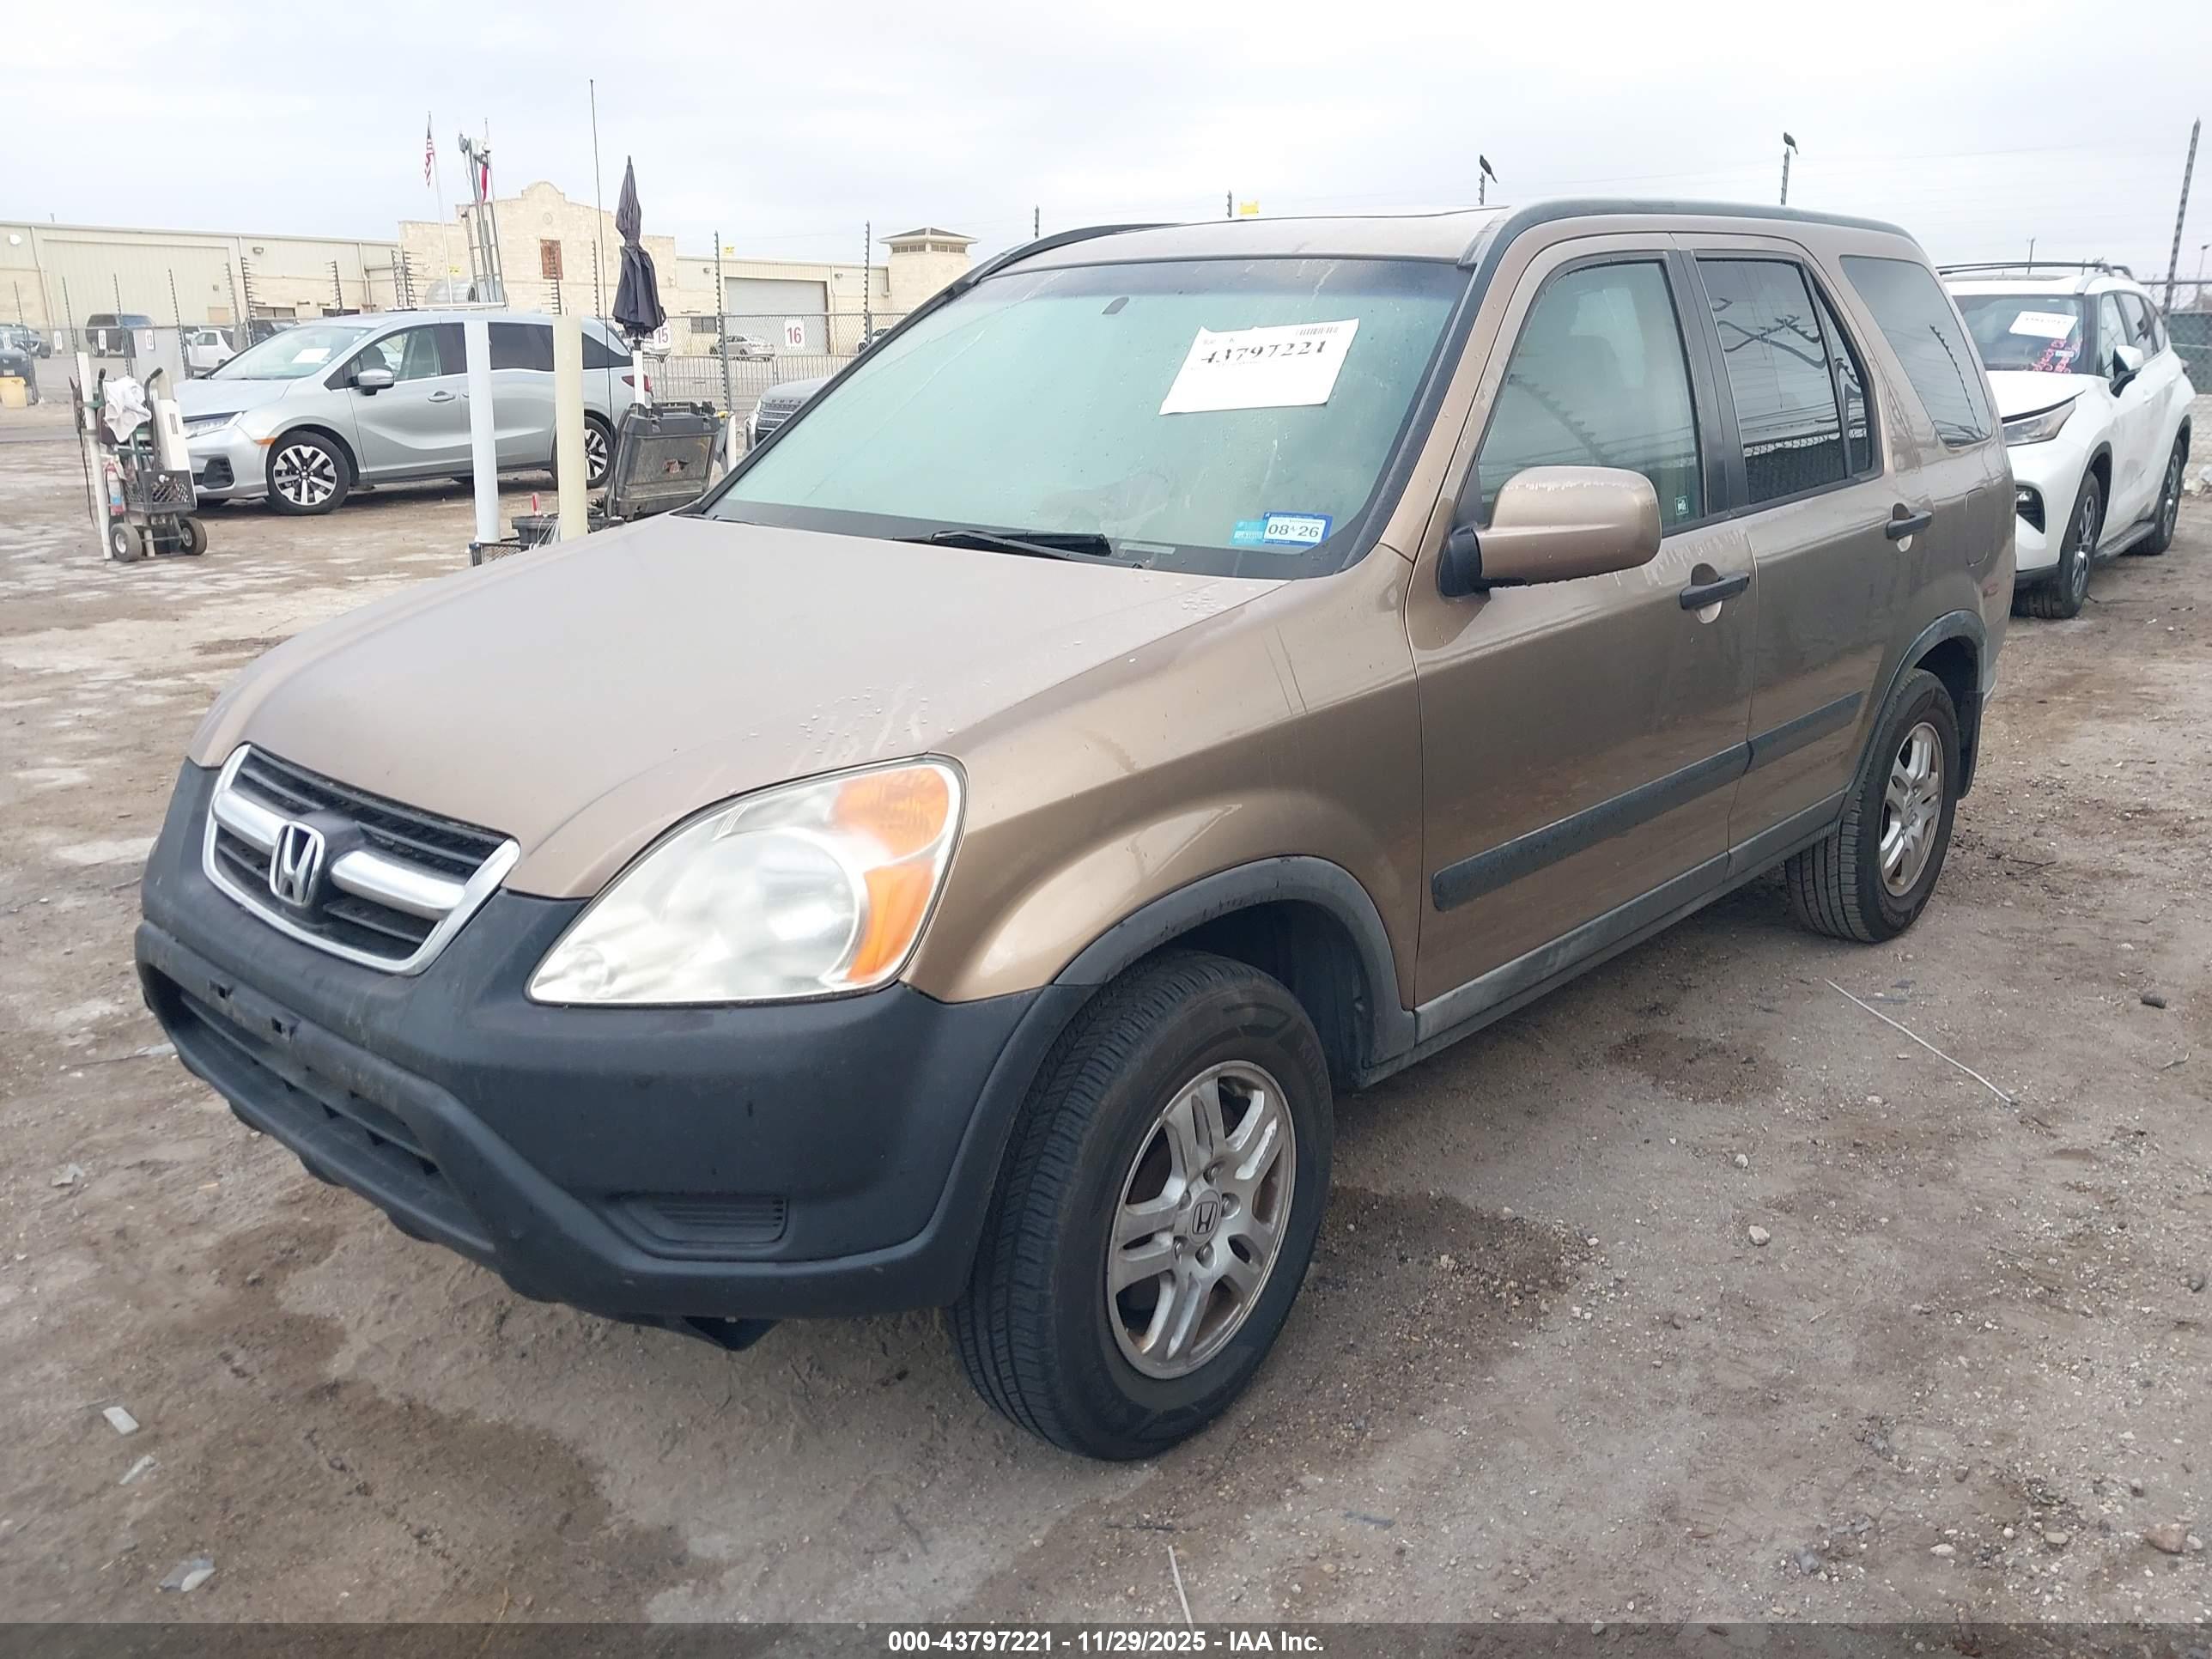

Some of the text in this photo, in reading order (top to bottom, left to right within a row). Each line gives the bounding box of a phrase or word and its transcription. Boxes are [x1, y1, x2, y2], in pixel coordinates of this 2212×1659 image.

[655, 326, 668, 343] 15
[787, 326, 802, 343] 16
[1267, 524, 1320, 538] 08 26
